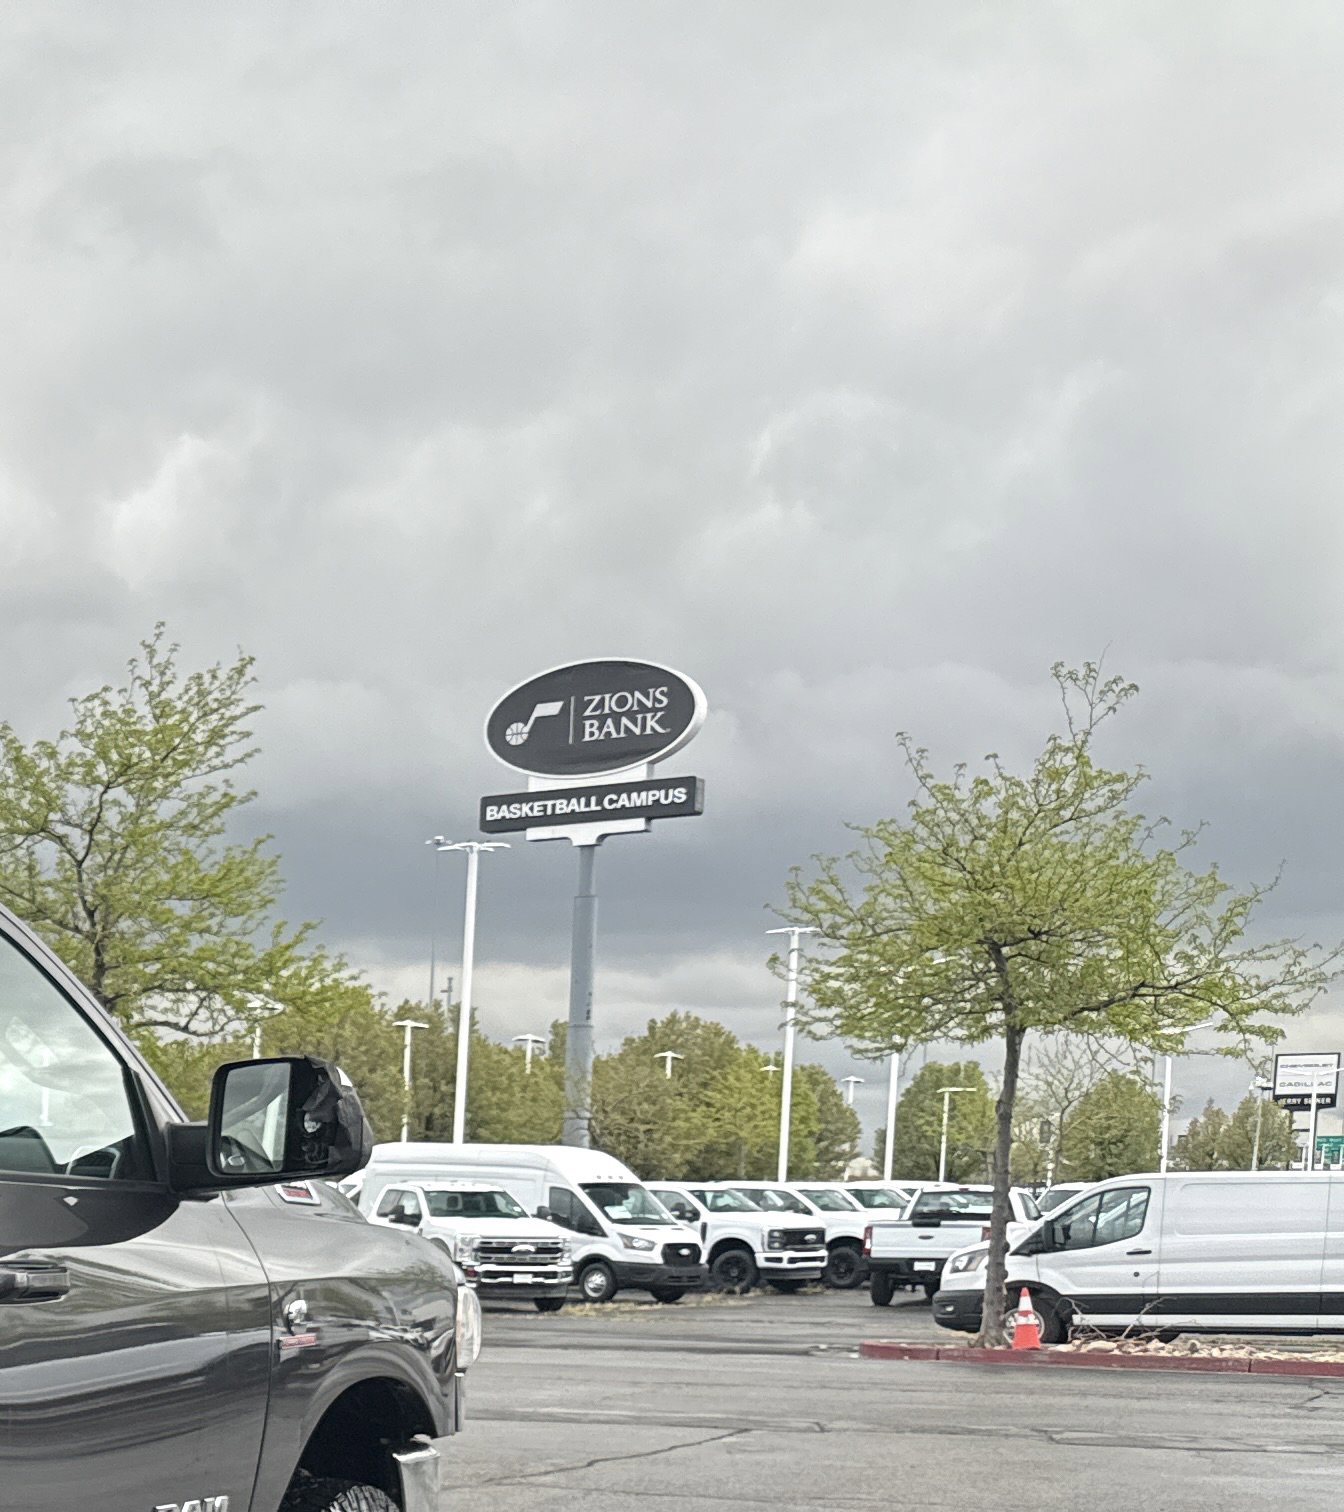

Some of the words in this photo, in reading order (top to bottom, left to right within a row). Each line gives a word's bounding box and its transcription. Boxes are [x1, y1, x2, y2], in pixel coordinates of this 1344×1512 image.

[582, 686, 669, 717] ZIONS
[581, 711, 667, 742] BANK
[485, 796, 602, 821] BASKETBALL
[603, 787, 687, 810] CAMPUS
